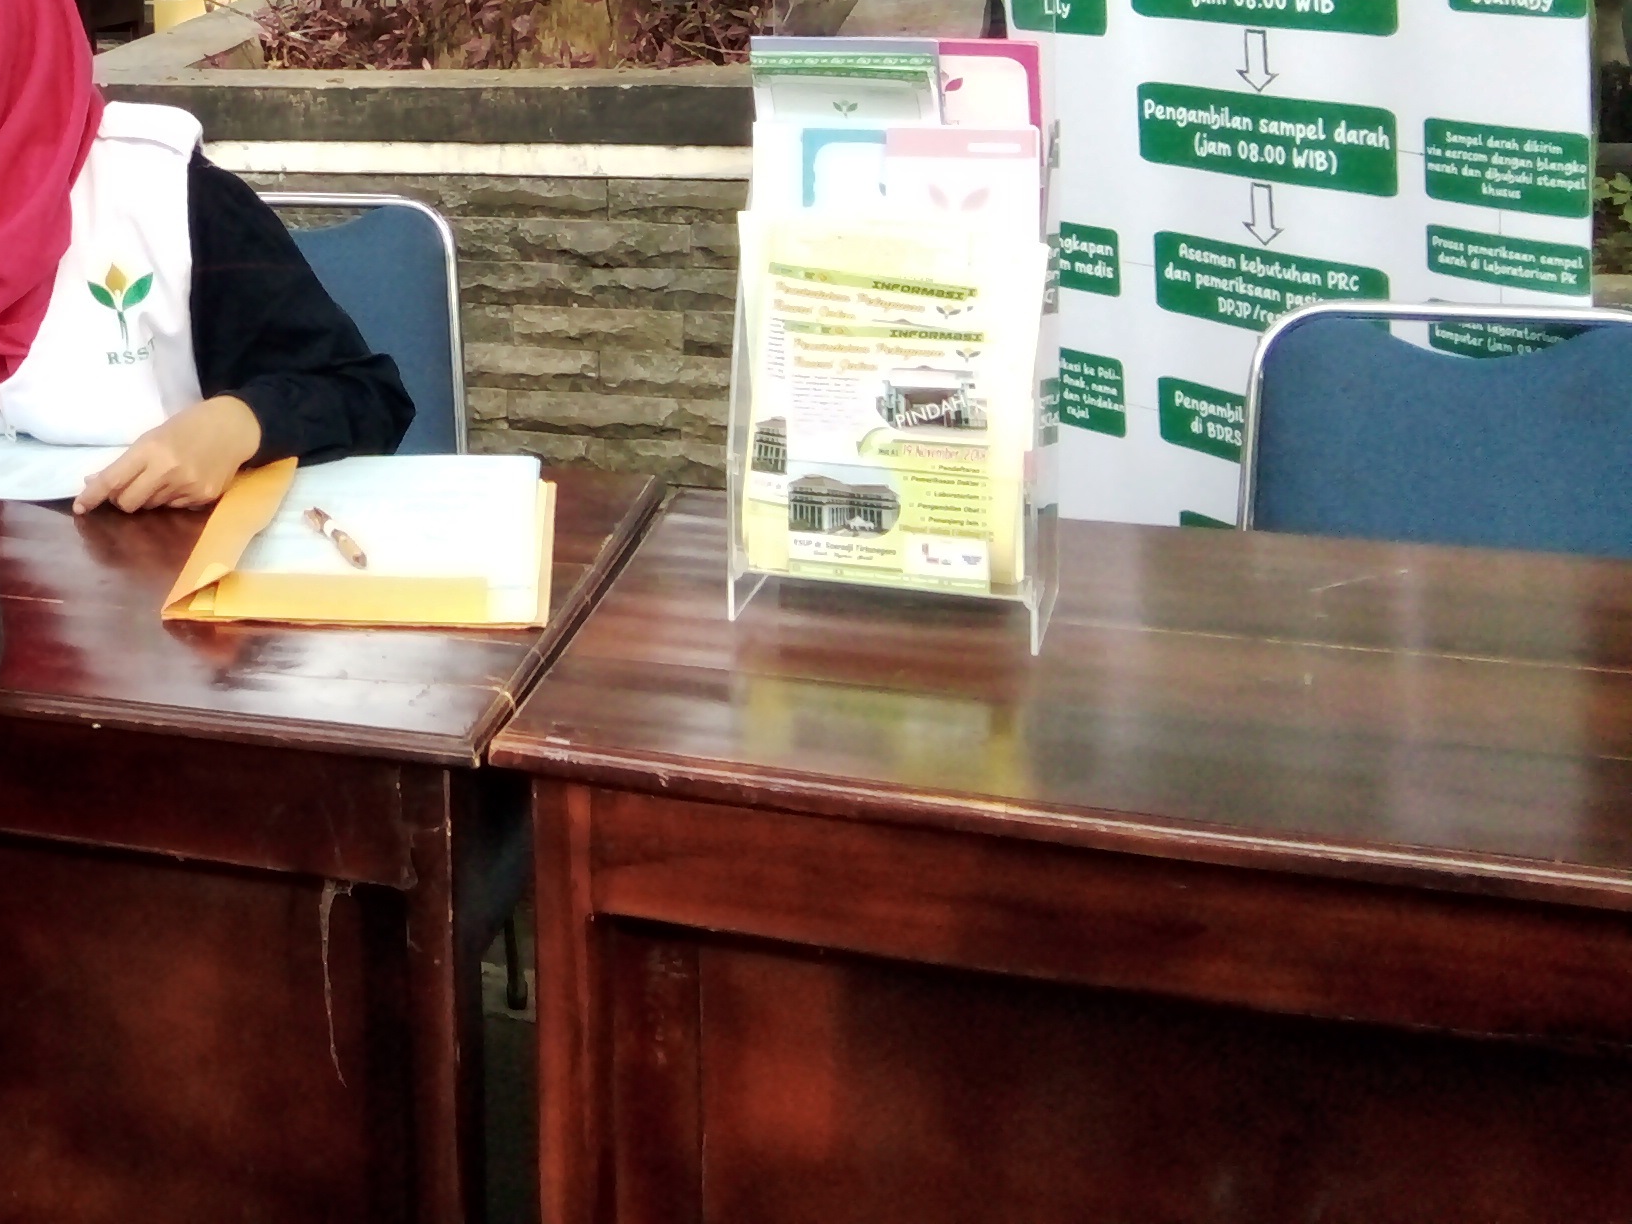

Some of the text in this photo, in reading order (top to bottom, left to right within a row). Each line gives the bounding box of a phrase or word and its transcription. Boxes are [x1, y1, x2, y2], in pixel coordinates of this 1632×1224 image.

[1142, 99, 1391, 151] Pengambilan sampel darah
[1445, 131, 1484, 149] Sampel
[1486, 134, 1520, 151] darah
[1193, 134, 1339, 176] (jam 08.00 WIB)
[1058, 233, 1115, 258] ngkapan
[1074, 259, 1115, 280] medis
[1164, 262, 1193, 283] dan
[1195, 271, 1282, 303] pemeriksaan
[1178, 242, 1360, 292] Asesmen kebutuhan PRC
[894, 392, 968, 428] PINDAH
[1174, 390, 1245, 424] Pengambil
[1190, 417, 1204, 434] di
